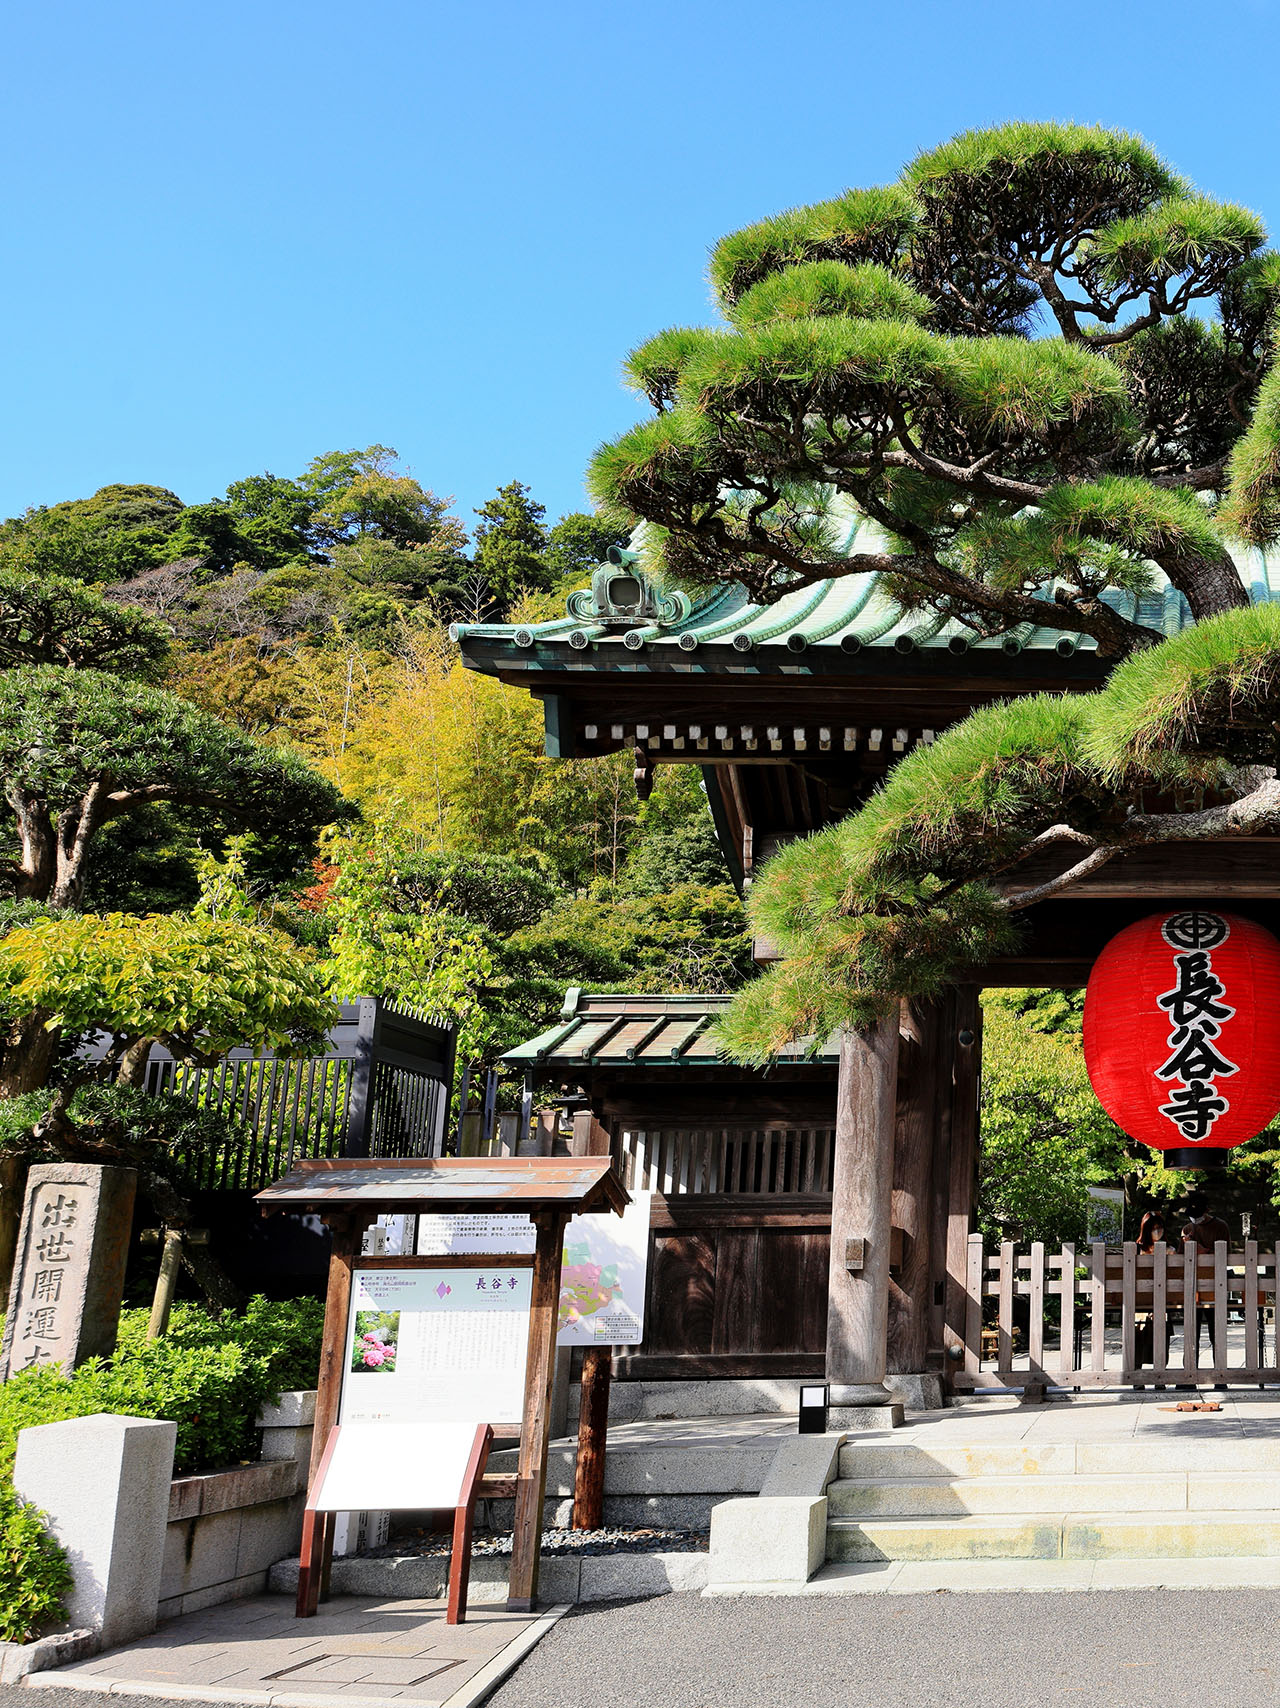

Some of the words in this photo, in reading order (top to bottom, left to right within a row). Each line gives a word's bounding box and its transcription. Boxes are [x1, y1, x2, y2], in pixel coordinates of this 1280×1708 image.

[1155, 951, 1238, 1140] 長谷寺
[475, 1277, 519, 1290] 長谷寺
